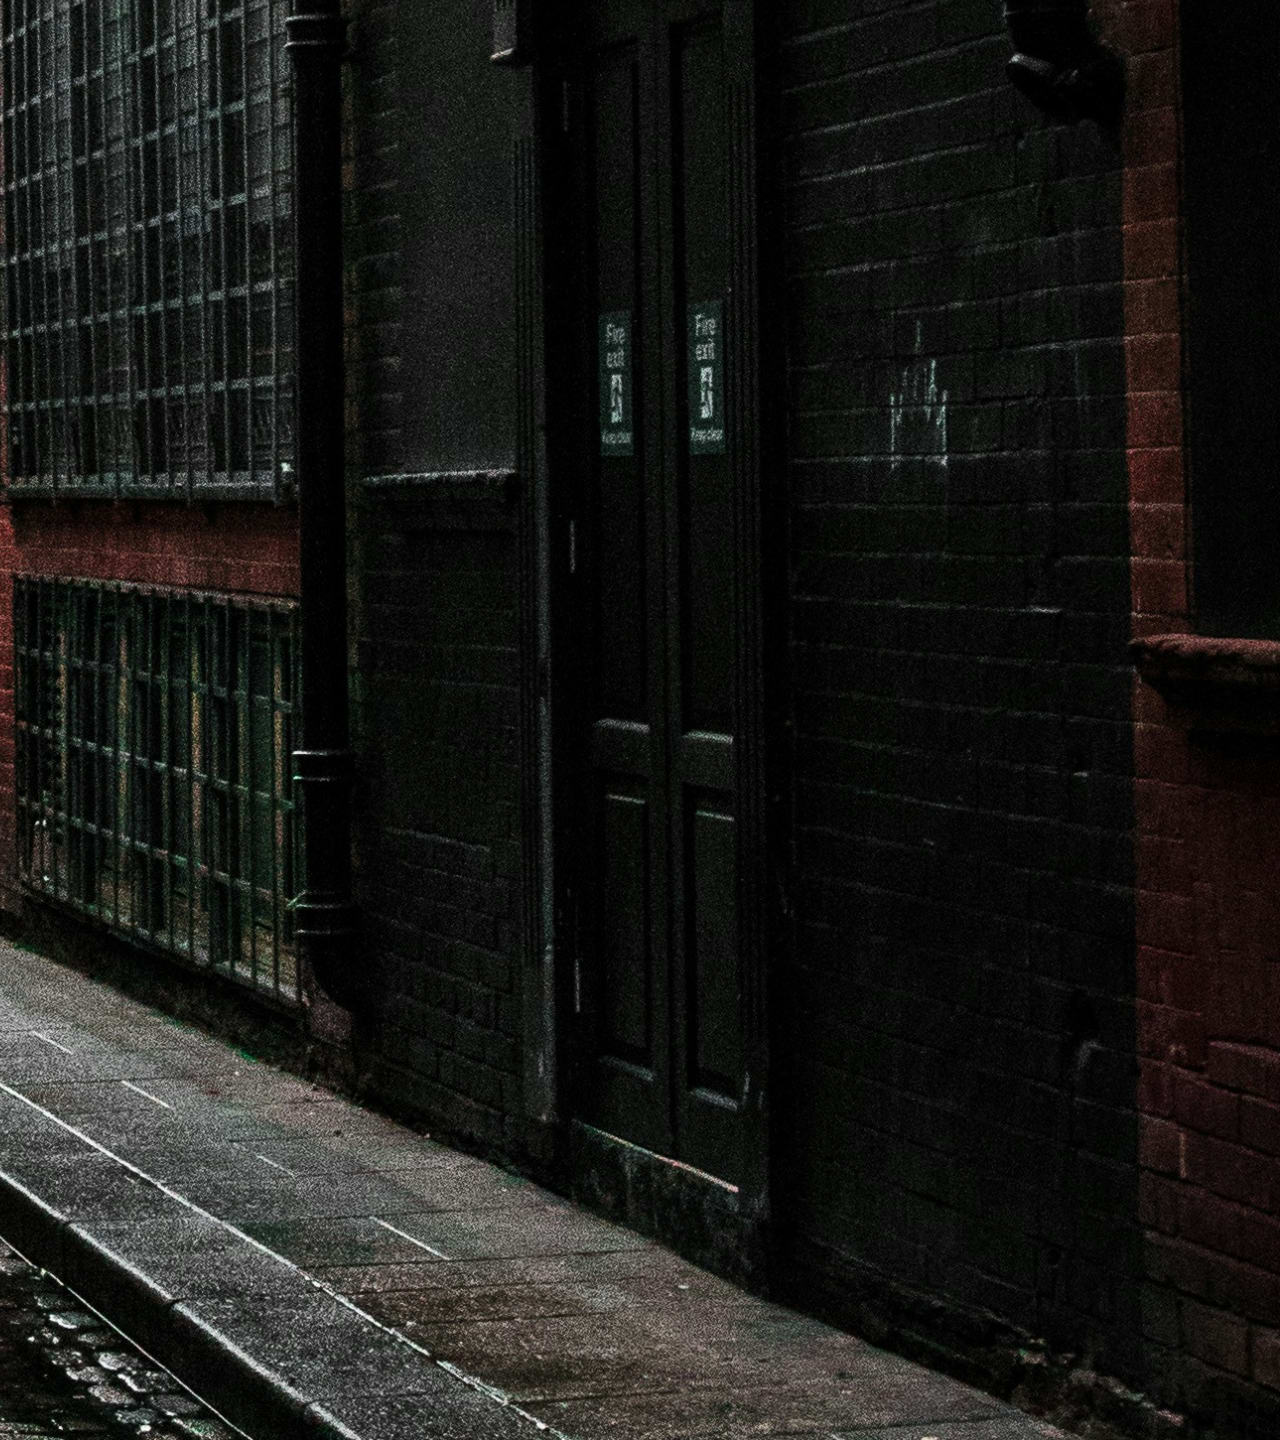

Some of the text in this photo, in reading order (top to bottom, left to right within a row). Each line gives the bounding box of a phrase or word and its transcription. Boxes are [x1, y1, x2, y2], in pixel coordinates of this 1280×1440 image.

[606, 323, 626, 345] Fire
[695, 313, 716, 335] Fire
[606, 347, 625, 369] exit
[695, 338, 715, 360] exit
